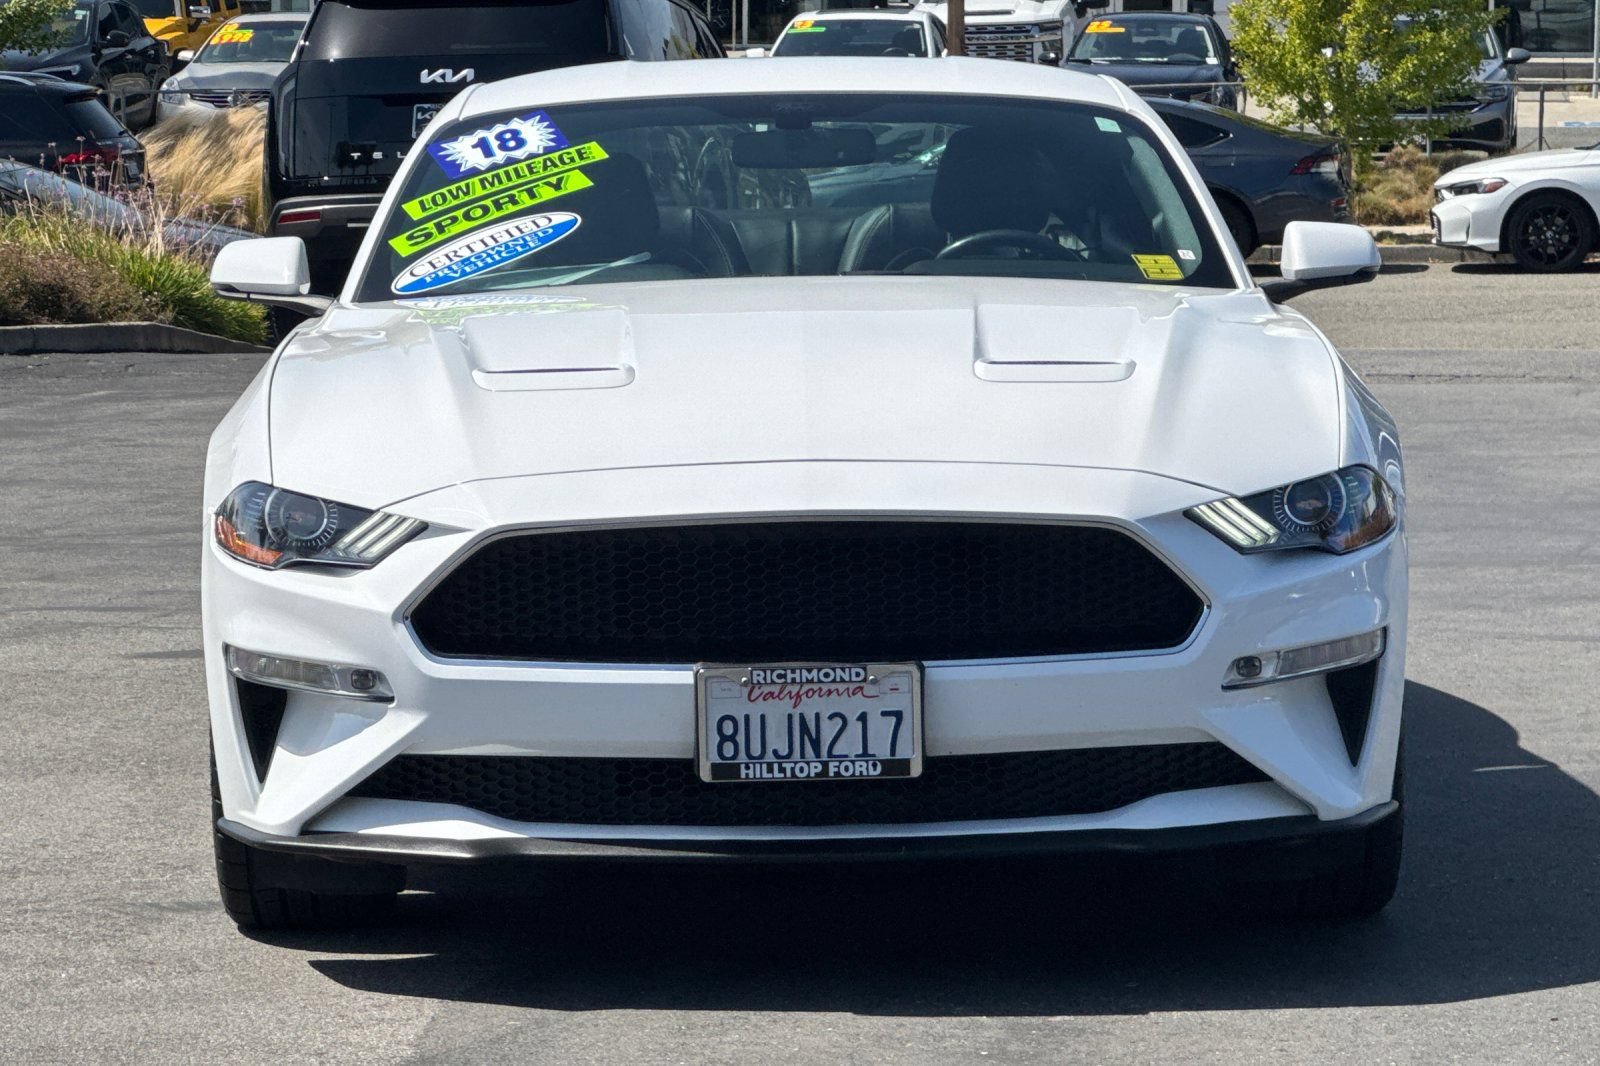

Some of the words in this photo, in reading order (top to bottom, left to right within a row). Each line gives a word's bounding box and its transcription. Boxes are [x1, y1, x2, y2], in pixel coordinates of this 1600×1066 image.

[471, 128, 527, 159] 18
[418, 182, 471, 213] LOW
[479, 146, 595, 191] MILEAGE
[405, 175, 567, 247] SPORTY
[409, 215, 553, 278] CERTIFIED
[423, 228, 554, 283] PRE-OWNED
[447, 238, 543, 278] VEHICLE
[747, 685, 880, 709] California
[752, 668, 865, 684] RICHMOND
[716, 710, 904, 761] 8UJN217
[740, 763, 823, 779] HILLTOP
[828, 760, 882, 776] FORD
